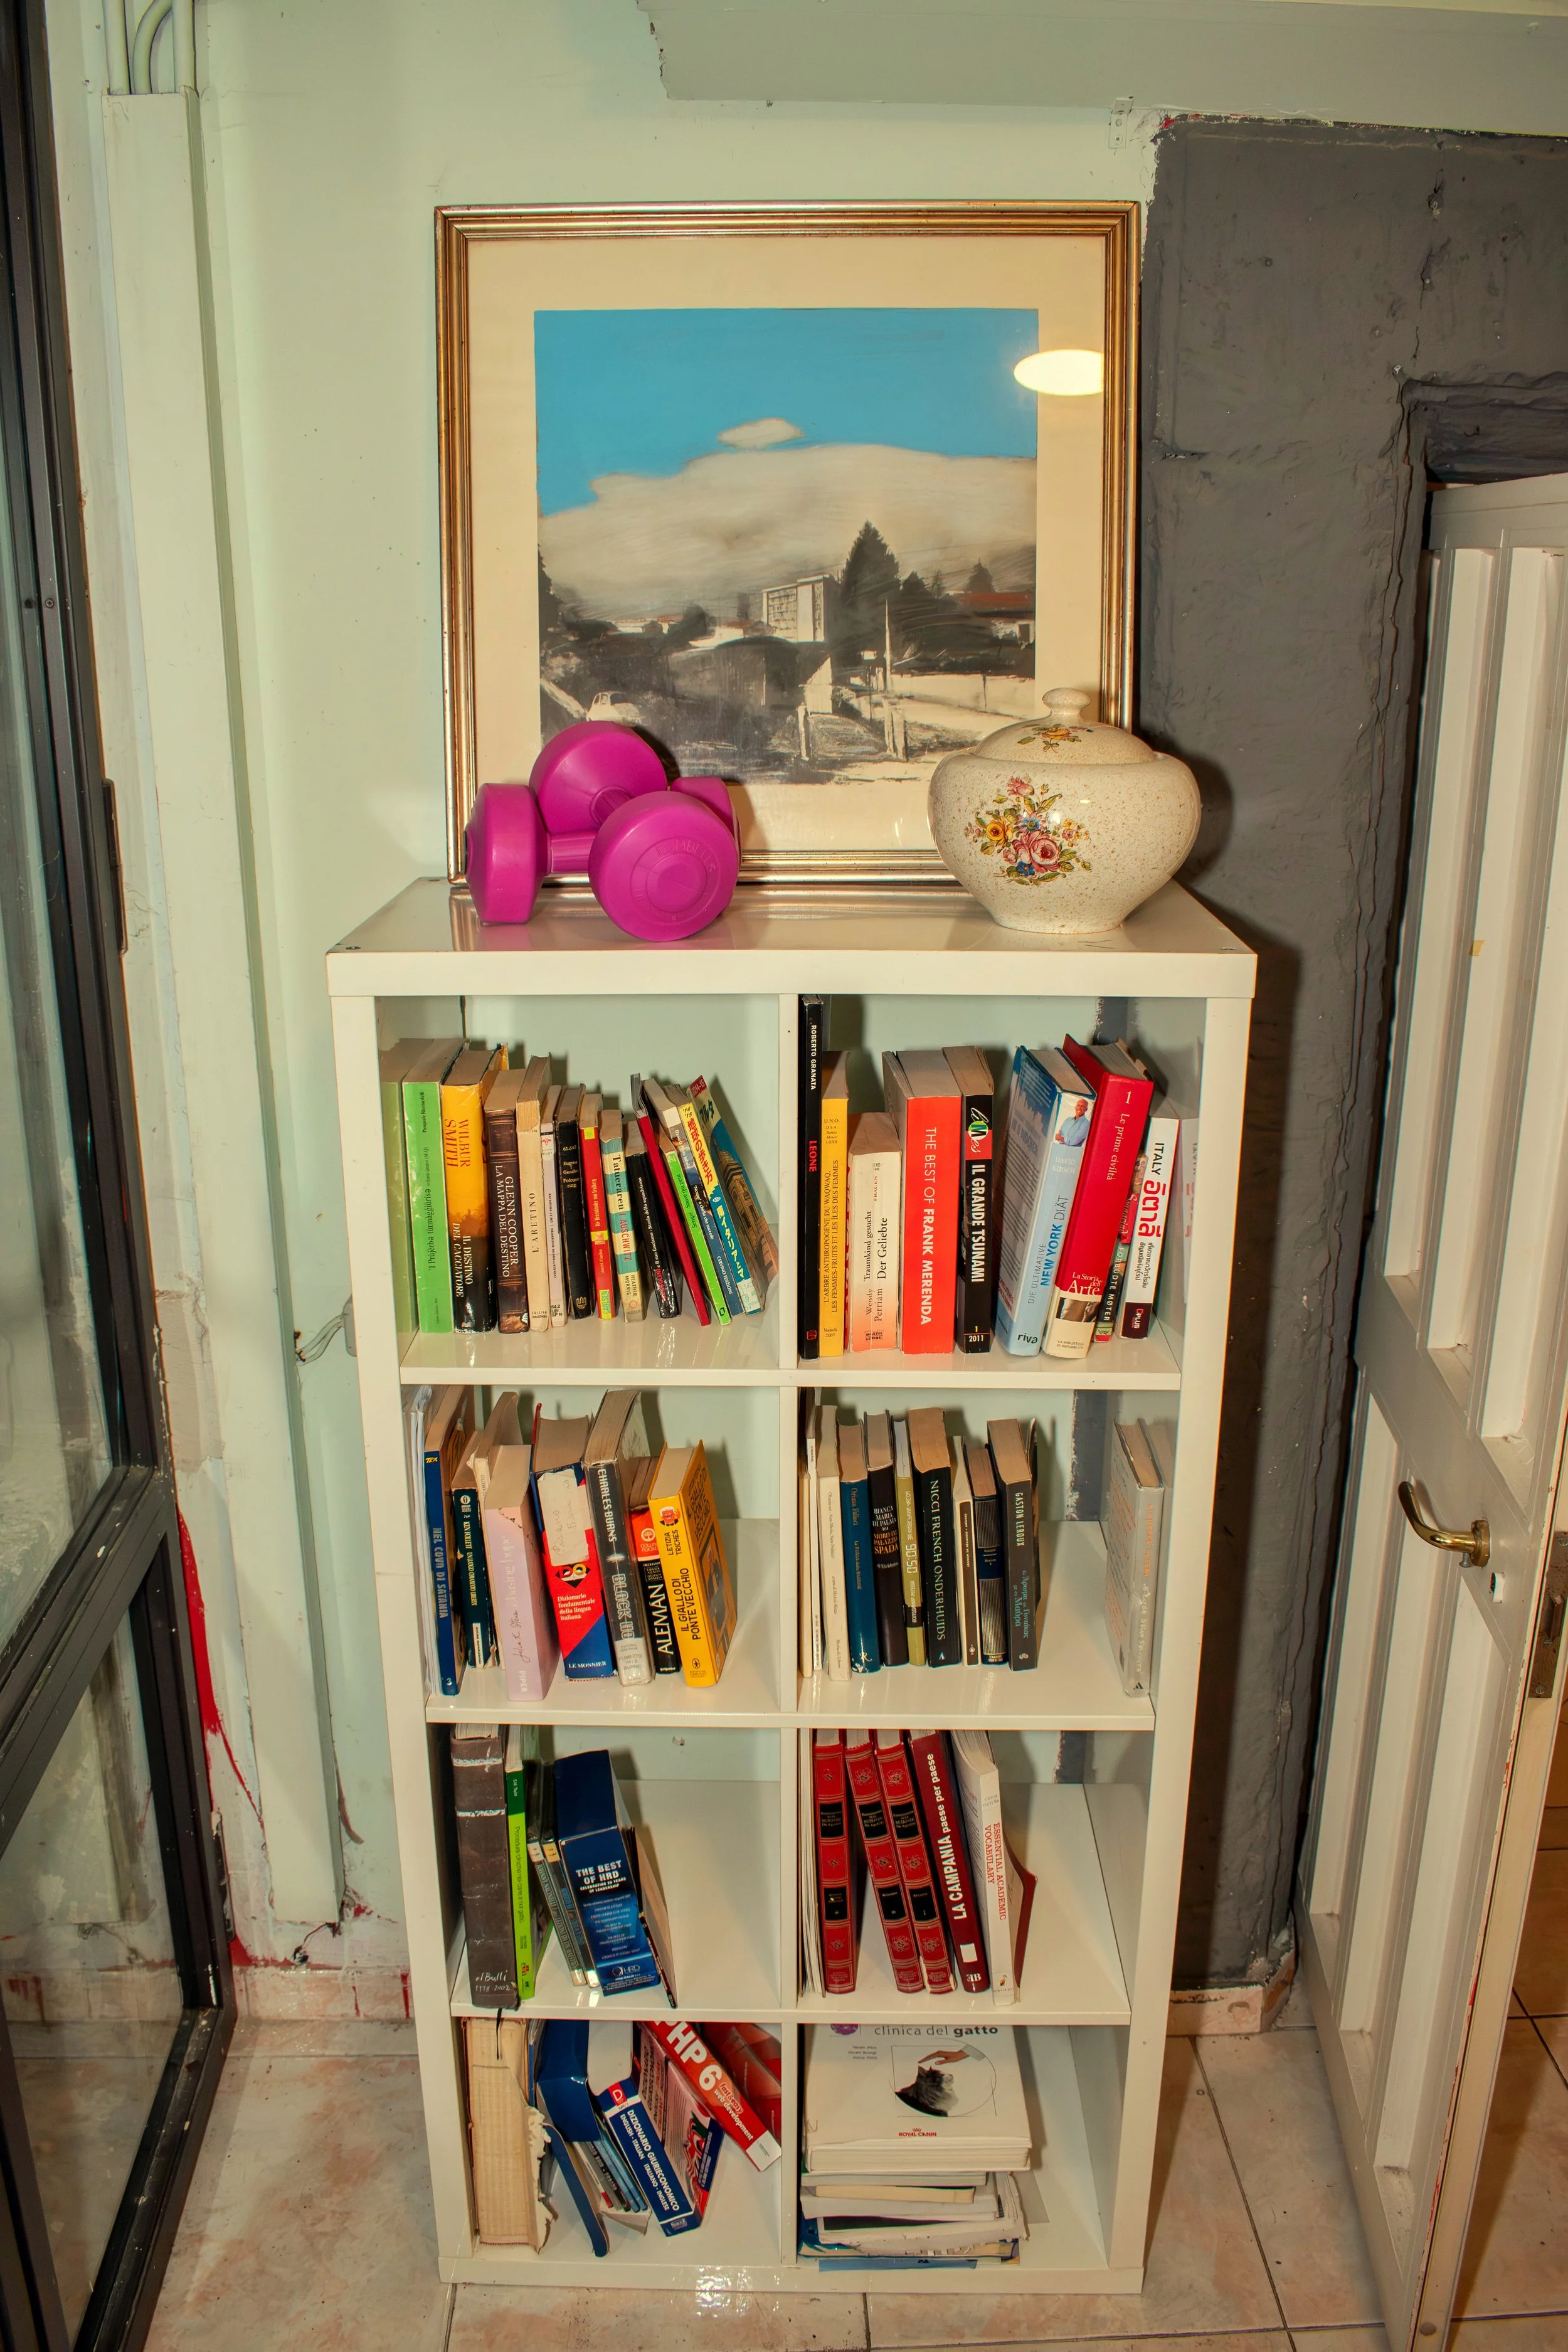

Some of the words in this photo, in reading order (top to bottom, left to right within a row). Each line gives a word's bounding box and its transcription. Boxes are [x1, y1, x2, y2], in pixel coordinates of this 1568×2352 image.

[1125, 1091, 1131, 1104] 1
[1119, 1113, 1130, 1125] Le
[444, 1119, 458, 1167] SMITH
[458, 1119, 471, 1167] WILBUR
[924, 1126, 937, 1150] THE
[1113, 1125, 1125, 1153] prime
[808, 1140, 817, 1172] LEONE
[924, 1155, 936, 1183] BEST
[972, 1164, 985, 1175] IL
[1106, 1154, 1118, 1181] civiltà
[1152, 1142, 1165, 1176] ITALY
[495, 1165, 503, 1177] LA
[495, 1180, 506, 1212] MAPPA
[505, 1175, 516, 1216] GLENN
[637, 1177, 647, 1203] squadrismo
[824, 1170, 832, 1204] WAQWAQ,
[923, 1187, 935, 1204] OF
[612, 1154, 624, 1210] Tatueraren
[619, 1219, 632, 1261] AUSCHWITZ
[824, 1205, 830, 1216] DU
[972, 1178, 985, 1226] GRANDE
[1053, 1195, 1069, 1221] DIÄT
[1137, 1180, 1167, 1237] อิตาลี
[453, 1222, 461, 1240] DEL
[644, 1216, 652, 1230] Storia
[706, 1224, 714, 1240] succede
[865, 1211, 873, 1239] gesucht
[922, 1209, 935, 1256] FRANK
[463, 1235, 471, 1244] IL
[507, 1219, 519, 1265] COOPER
[649, 1232, 658, 1252] fascismo
[832, 1235, 838, 1244] ET
[877, 1217, 888, 1259] Geliebte
[1047, 1224, 1062, 1258] YORK
[453, 1242, 464, 1298] CACCIATORE
[463, 1247, 474, 1285] DESTINO
[500, 1235, 510, 1278] DESTINO
[877, 1261, 886, 1279] Der
[971, 1229, 985, 1283] TSUNAMI
[1033, 1243, 1046, 1288] ULTIMATIVE
[1109, 1246, 1124, 1290] FORBUDTE
[716, 1256, 728, 1276] CERVINO
[723, 1275, 733, 1295] EDIZIONI
[1040, 1258, 1055, 1286] NEW
[1072, 1271, 1081, 1280] La
[1082, 1273, 1099, 1282] Storia
[866, 1288, 875, 1315] Wendy
[920, 1259, 933, 1325] MERENDA
[1066, 1279, 1101, 1296] Arte
[601, 1291, 610, 1314] CARLSEN
[874, 1288, 882, 1322] Perriam
[1103, 1293, 1114, 1321] MØTER
[1017, 1332, 1038, 1344] riva
[598, 1468, 612, 1510] CHARLES
[930, 1480, 940, 1517] NICCI
[874, 1506, 894, 1514] BIANCA
[876, 1512, 893, 1520] MARIA
[1015, 1492, 1024, 1519] GASTON
[433, 1527, 442, 1544] NEL
[464, 1531, 472, 1549] FOLLETT
[604, 1511, 617, 1542] BURNS
[874, 1531, 891, 1540] MORD
[1017, 1521, 1025, 1547] LEROUX
[664, 1532, 674, 1555] LETIZIA
[672, 1529, 682, 1556] TRICHES
[874, 1535, 898, 1547] PALAZZO
[874, 1542, 899, 1554] SPADA
[931, 1520, 941, 1564] FRENCH
[434, 1546, 445, 1569] COVO
[906, 1544, 917, 1574] 05:06
[436, 1571, 445, 1581] DI
[680, 1567, 695, 1610] VECCHIO
[437, 1584, 448, 1619] SATANIA
[557, 1592, 586, 1602] Dizionario
[558, 1598, 595, 1608] fondamentale
[573, 1606, 591, 1614] lingua
[612, 1573, 632, 1620] BLACK
[674, 1589, 687, 1623] GIALLO
[933, 1566, 946, 1641] ONDERHUIDS
[648, 1584, 674, 1655] ALEMÁN
[687, 1609, 701, 1640] PONTE
[447, 1678, 452, 1686] 3
[519, 1670, 527, 1693] PIPER
[927, 1753, 940, 1783] paese
[933, 1785, 945, 1802] per
[937, 1804, 951, 1833] paese
[984, 1825, 995, 1884] VOCABULARY
[993, 1821, 1003, 1872] ESSENTIAL
[575, 1867, 595, 1878] THE
[596, 1860, 622, 1873] BEST
[583, 1875, 596, 1885] OF
[598, 1870, 620, 1883] HRD
[937, 1835, 963, 1901] CAMPANIA
[580, 1881, 607, 1891] CELEBRATING
[595, 1883, 620, 1892] LEADERSHIP
[997, 1873, 1007, 1920] ACADEMIC
[952, 1902, 967, 1920] LA
[623, 1964, 640, 1973] HRD
[874, 2025, 921, 2036] clinica
[926, 2025, 949, 2036] del
[953, 2025, 999, 2037] gatto
[699, 2064, 723, 2091] 6
[719, 2082, 744, 2114] fast&easy
[714, 2089, 726, 2104] web
[723, 2101, 754, 2141] development
[627, 2109, 652, 2153] DIZIONARIO
[620, 2114, 634, 2137] ENGLISH
[632, 2139, 645, 2160] ITALIAN
[644, 2164, 659, 2188] ITALIANO
[657, 2190, 670, 2212] INGLESE
